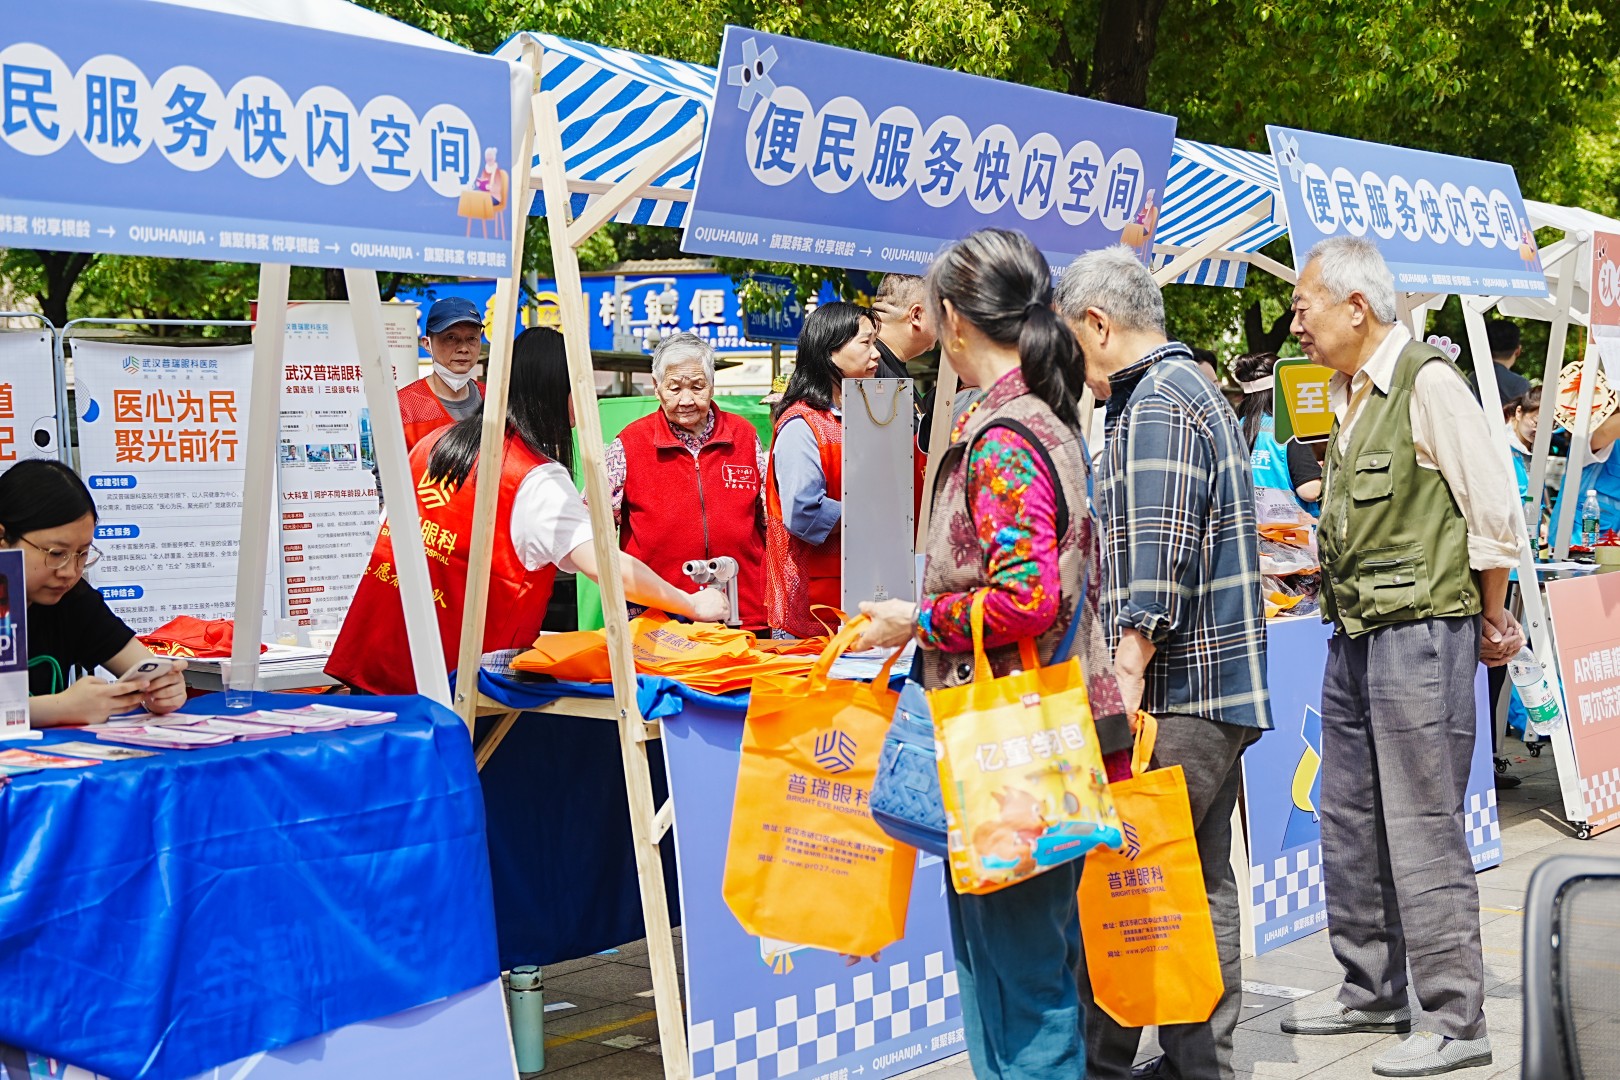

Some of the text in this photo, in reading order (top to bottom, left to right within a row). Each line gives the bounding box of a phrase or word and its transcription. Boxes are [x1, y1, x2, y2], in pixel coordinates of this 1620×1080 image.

[2, 63, 470, 185] 民服务快闪空间
[753, 103, 1140, 222] 便民服务快闪空间
[1306, 175, 1519, 242] 便民服务快闪空间
[129, 225, 206, 245] QIJUHANJIA
[350, 242, 413, 261] QIJUHANJIA
[694, 226, 759, 246] QIJUHANJIA
[142, 358, 218, 369] 武汉普瑞眼科医院
[113, 388, 237, 423] 医心为民
[114, 428, 239, 463] 聚光前行
[95, 477, 129, 487] 党建引领
[98, 527, 131, 537] 五全服务
[419, 518, 458, 556] 眼科
[423, 546, 450, 566] OSPITAL
[102, 587, 136, 599] 五种结合
[974, 722, 1086, 772] 亿童学习包
[788, 773, 870, 807] 普瑞眼科
[786, 793, 870, 819] BRIGHT EYE HOSPITAL
[1106, 865, 1164, 890] 普瑞眼科
[1111, 885, 1166, 898] BRIGHT EYE HOSPITAL
[872, 1043, 923, 1071] QIJUHANJIA
